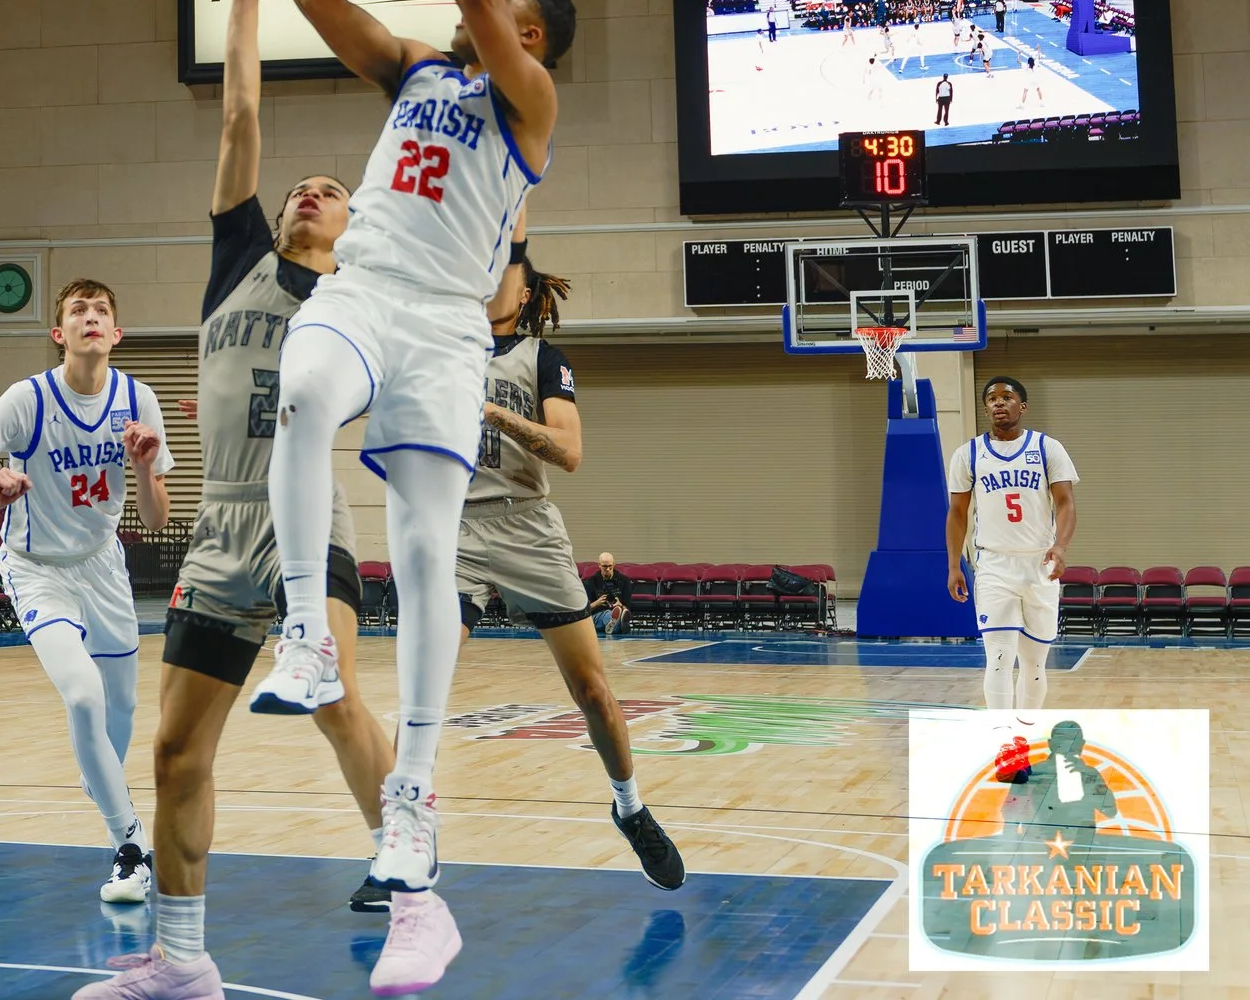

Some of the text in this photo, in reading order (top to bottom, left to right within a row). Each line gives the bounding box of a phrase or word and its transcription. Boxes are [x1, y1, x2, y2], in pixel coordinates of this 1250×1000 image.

[393, 98, 485, 150] PARISH
[864, 136, 913, 157] 4:30
[390, 139, 450, 204] 22
[875, 159, 905, 194] 10
[743, 242, 784, 253] PENALTY
[992, 239, 1036, 254] GUEST
[1055, 233, 1094, 245] PLAYER
[1111, 230, 1156, 243] PENALTY
[691, 244, 727, 255] PLAYER
[894, 280, 930, 291] PERIOD
[247, 368, 280, 438] 2
[48, 441, 125, 472] PARISH
[71, 469, 110, 508] 24
[980, 469, 1041, 493] PARISH
[1005, 493, 1022, 523] 5
